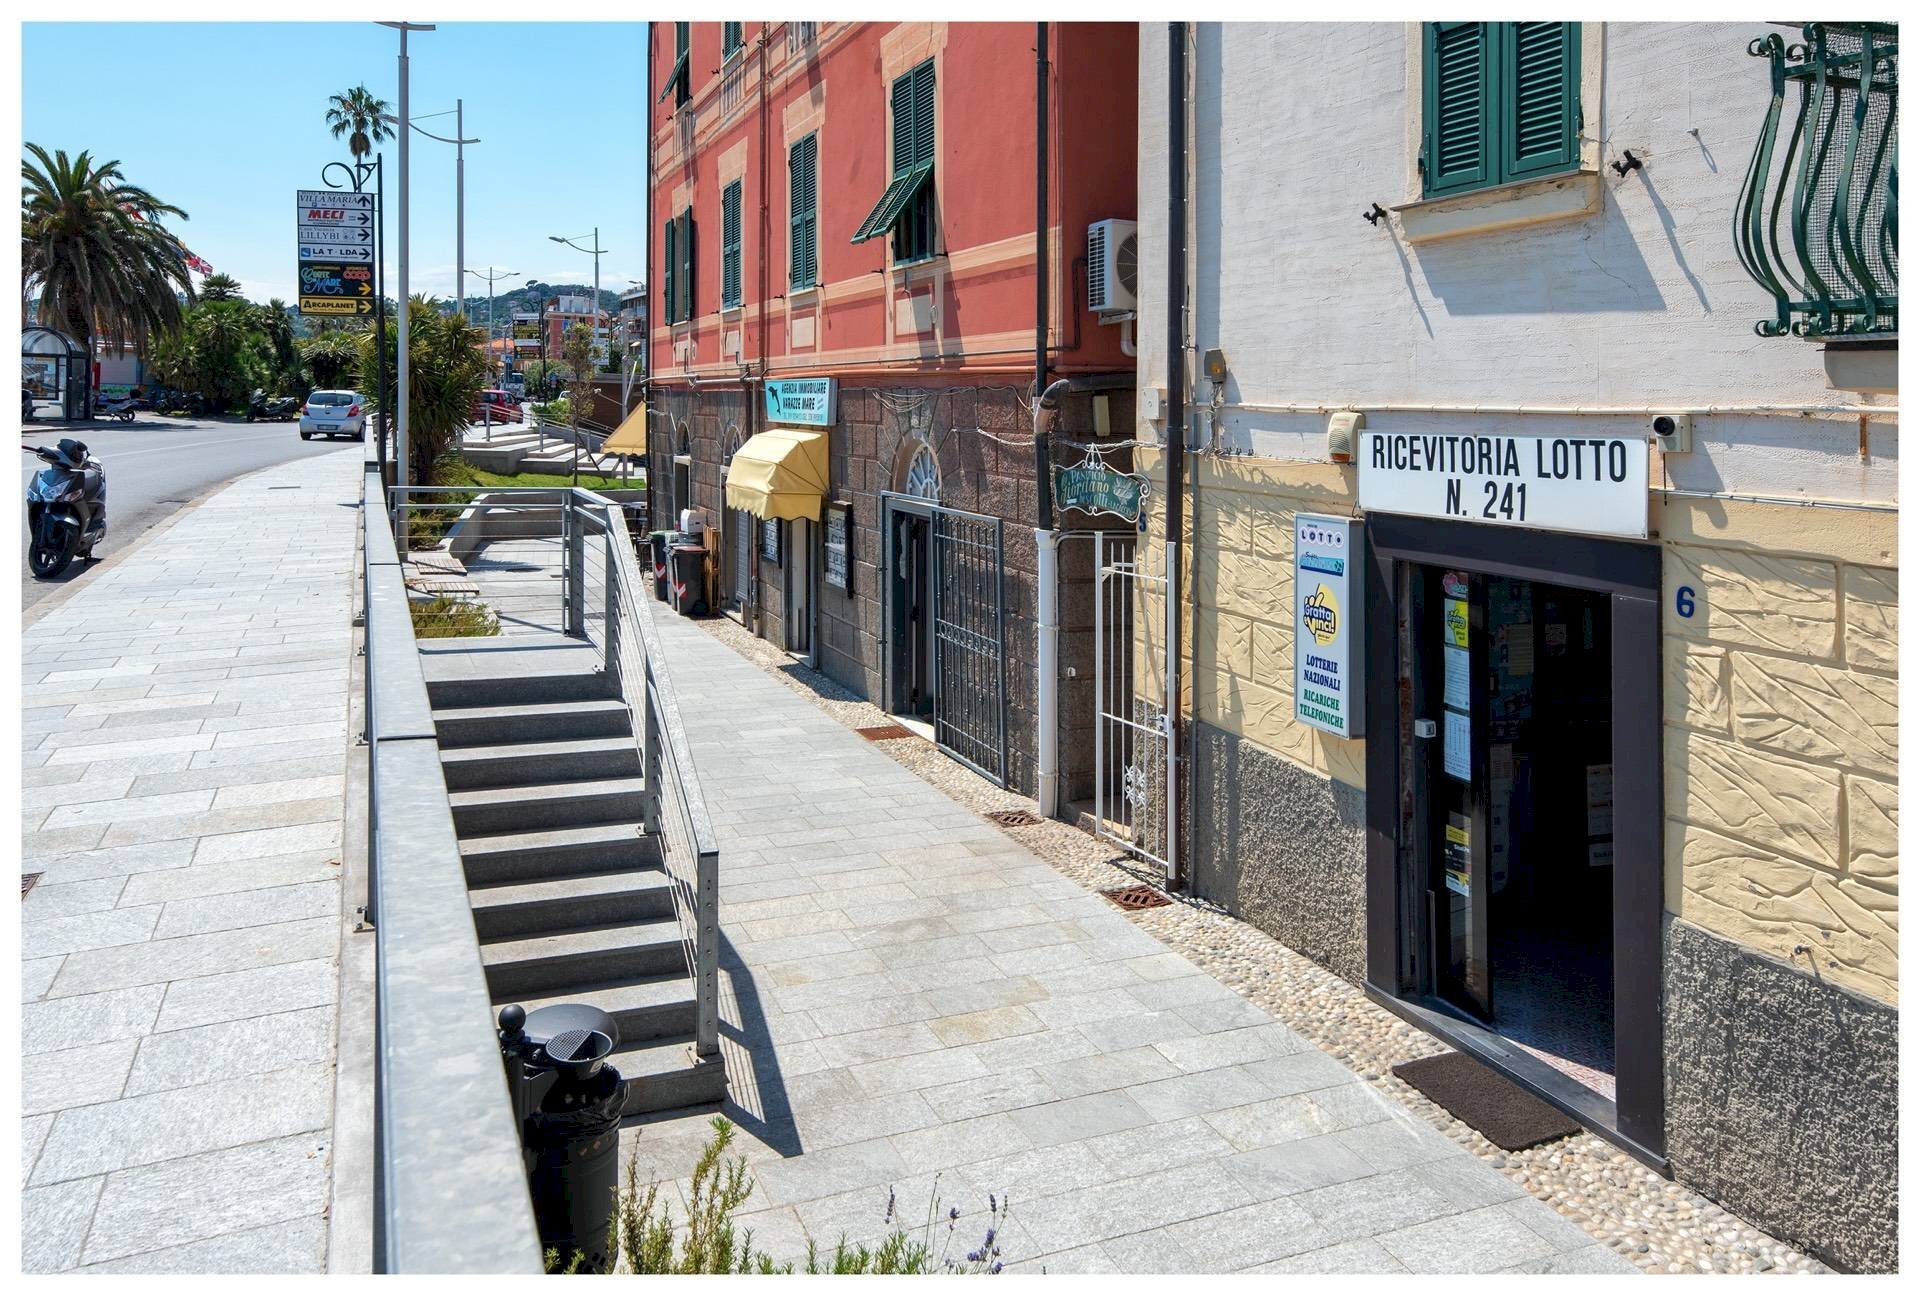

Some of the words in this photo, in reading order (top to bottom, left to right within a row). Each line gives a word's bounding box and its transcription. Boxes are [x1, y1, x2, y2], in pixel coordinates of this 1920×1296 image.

[300, 194, 325, 203] VILLA
[327, 195, 358, 203] MARIA
[308, 210, 345, 219] MECI
[300, 231, 340, 240] LILLYBI
[303, 300, 355, 309] ARCAPLANET
[781, 383, 797, 394] AGENZIA
[798, 382, 827, 394] IMMOBILIARE
[801, 397, 816, 410] MARE
[1372, 434, 1521, 477] RICEVITORIA
[1536, 438, 1627, 483] LOTTO
[1445, 478, 1467, 516] N.
[1483, 480, 1527, 522] 241
[1675, 585, 1696, 619] 6
[1304, 604, 1332, 620] Gratta
[1306, 654, 1338, 674] LOTTERIE
[1303, 669, 1341, 691] NAZIONALI
[1303, 688, 1340, 711] RICARICHE
[1299, 703, 1344, 729] TELEFONICHE
